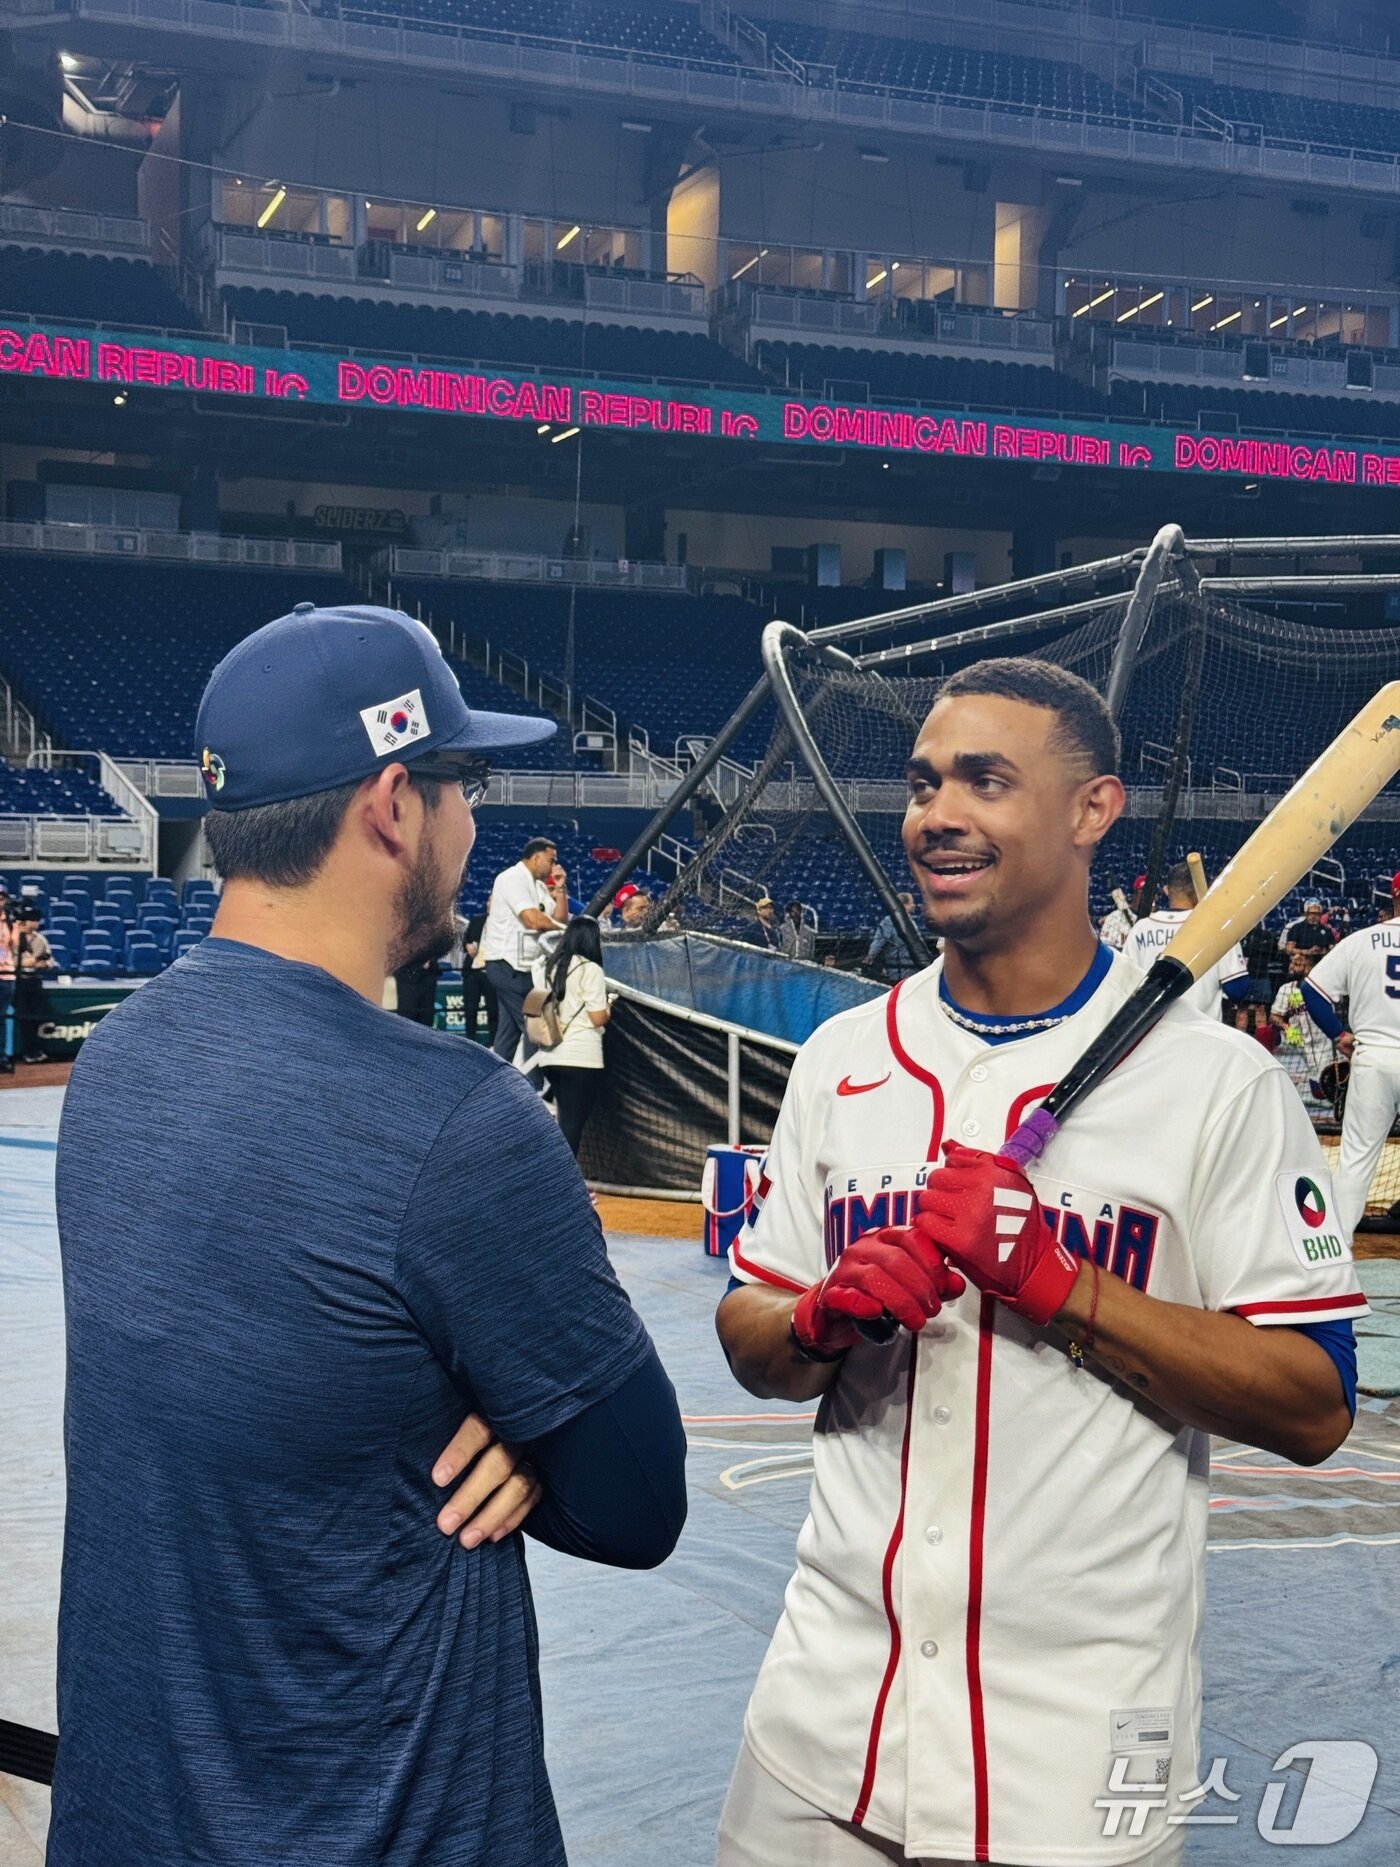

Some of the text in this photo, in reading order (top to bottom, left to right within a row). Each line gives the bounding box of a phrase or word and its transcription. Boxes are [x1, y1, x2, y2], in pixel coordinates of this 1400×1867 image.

[0, 328, 90, 379] CAN
[338, 361, 571, 423] DOMINICAN
[784, 403, 987, 456] DOMINICAN
[1174, 434, 1400, 486] DOMINICAN RE
[1135, 929, 1174, 951] MACH
[1302, 1234, 1342, 1262] BHD
